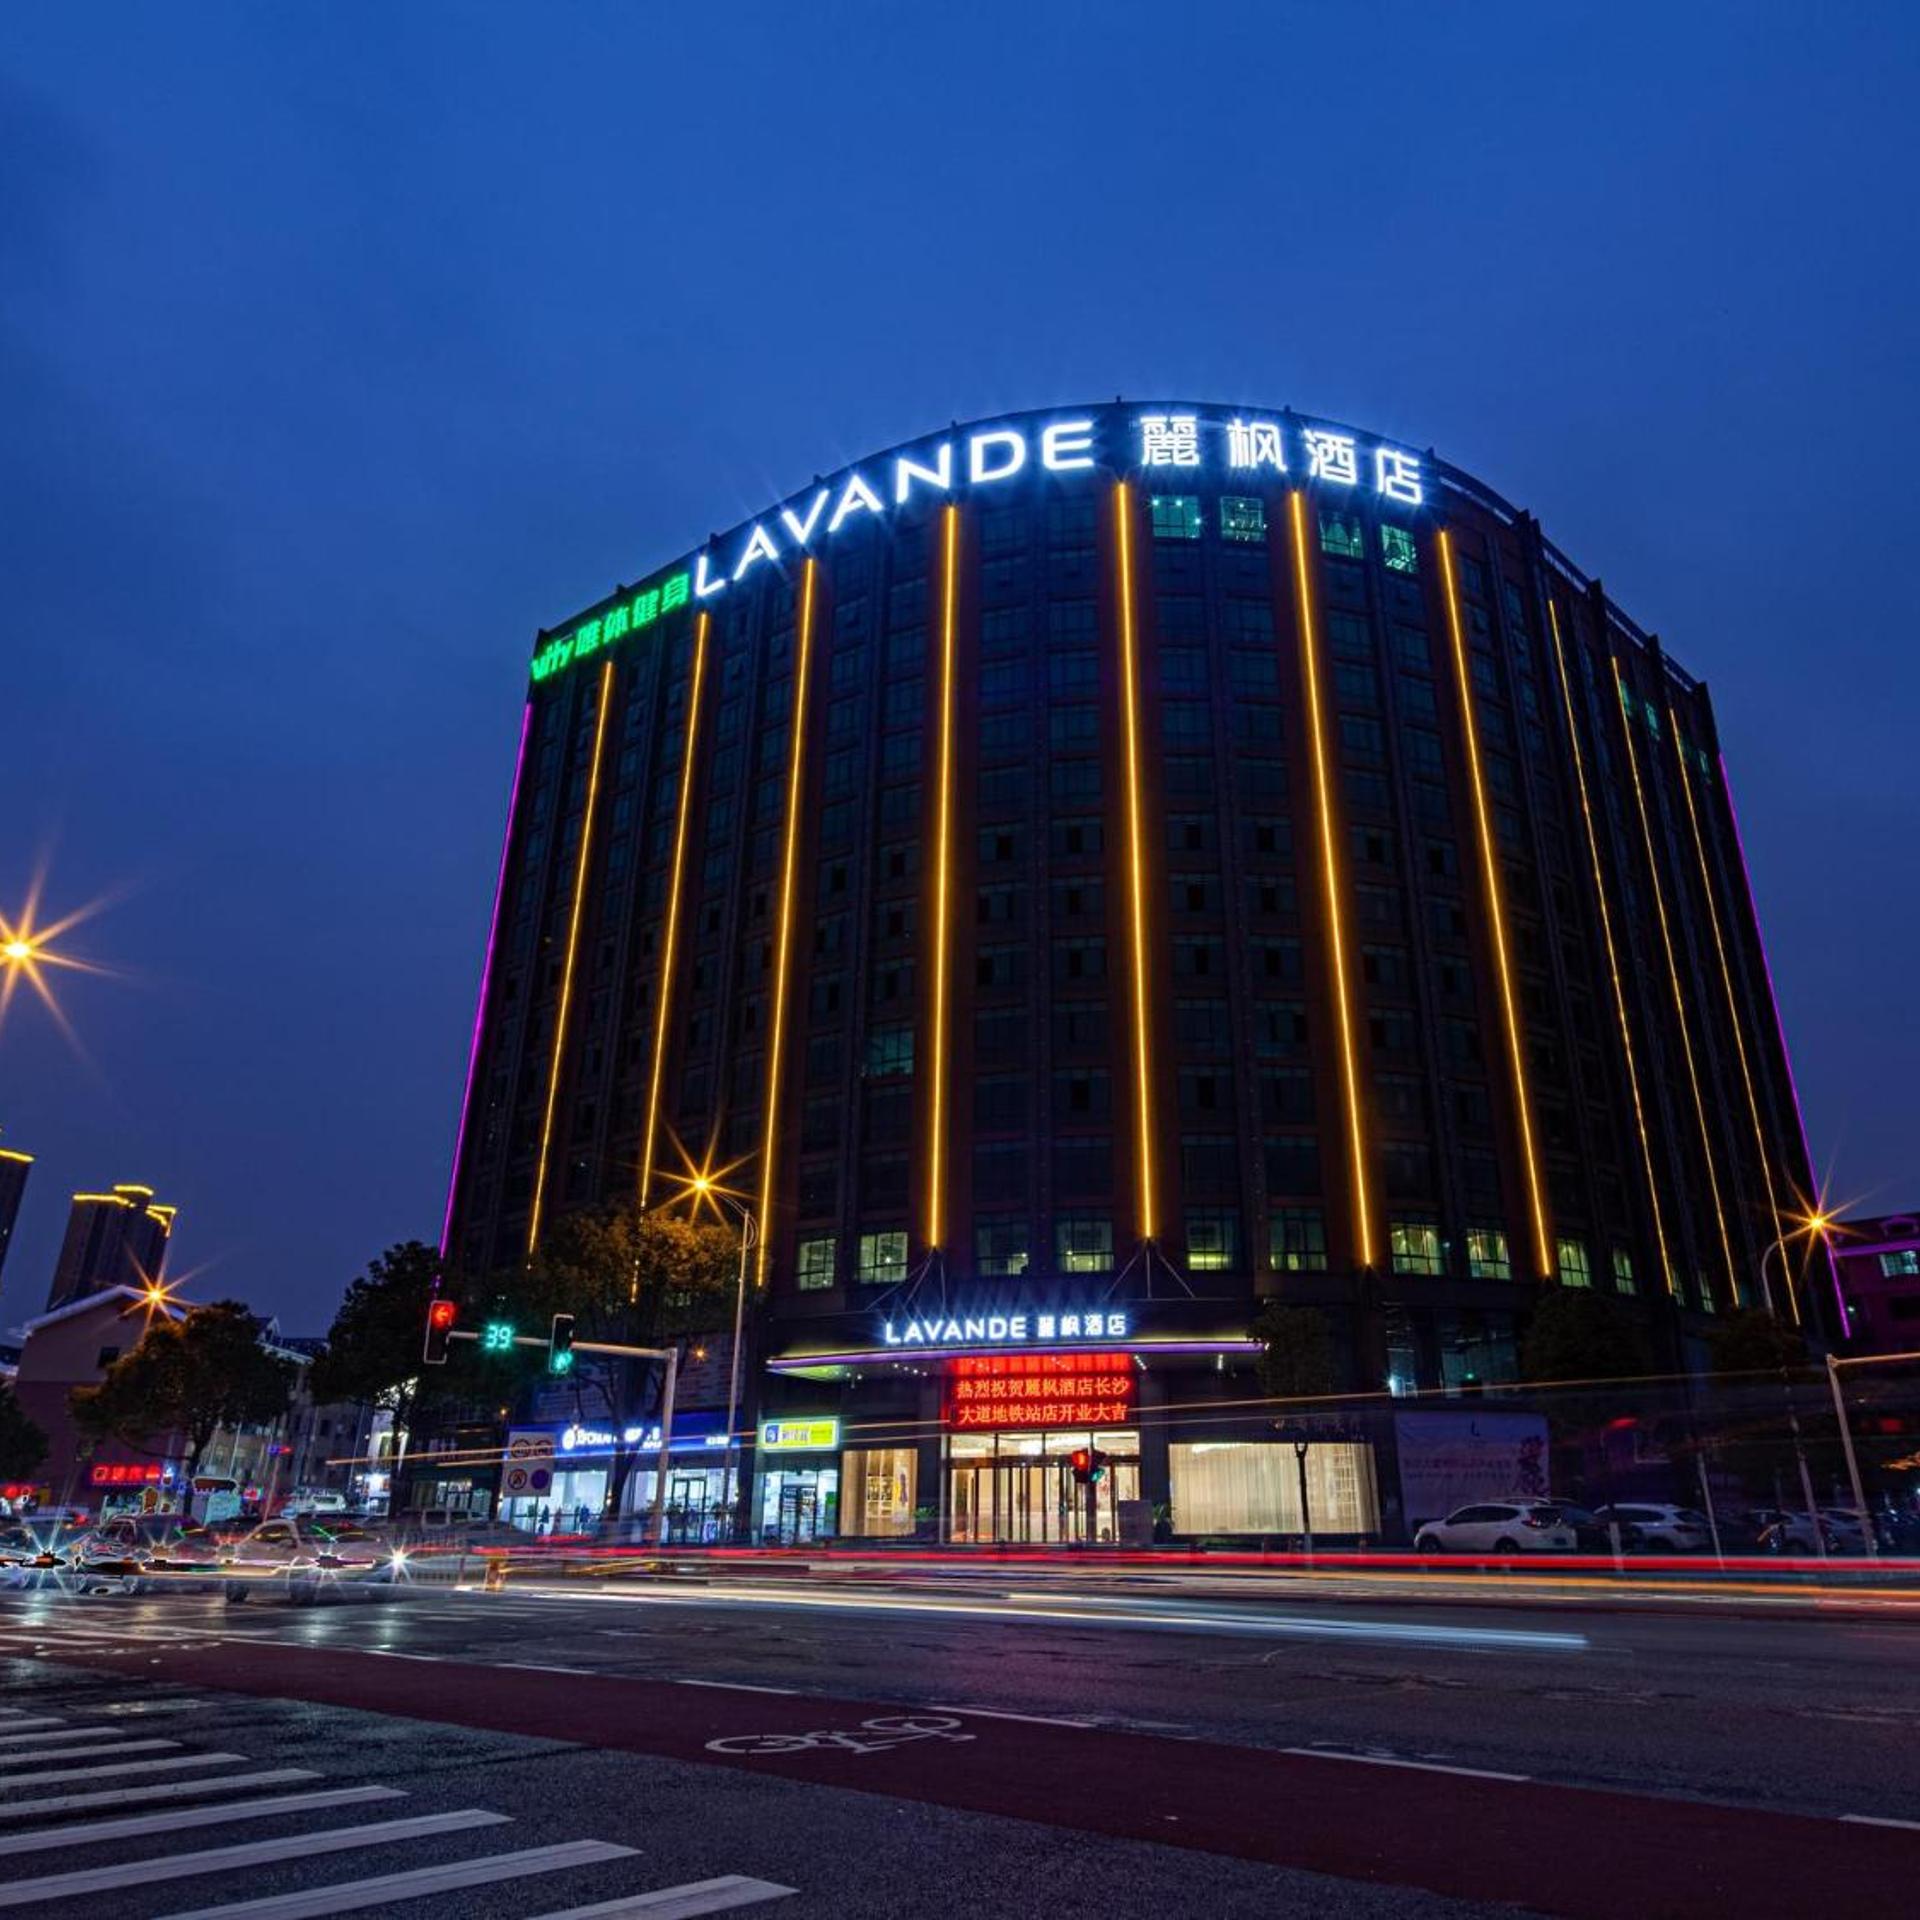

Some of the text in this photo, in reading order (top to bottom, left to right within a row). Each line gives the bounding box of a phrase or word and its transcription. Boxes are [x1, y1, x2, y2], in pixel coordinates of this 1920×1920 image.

[695, 415, 1424, 598] LAVANDE 麗枫酒店
[486, 1325, 511, 1349] 39
[885, 1316, 1027, 1344] LAVANDE
[958, 1401, 1128, 1425] 大道地铁站店开业大吉
